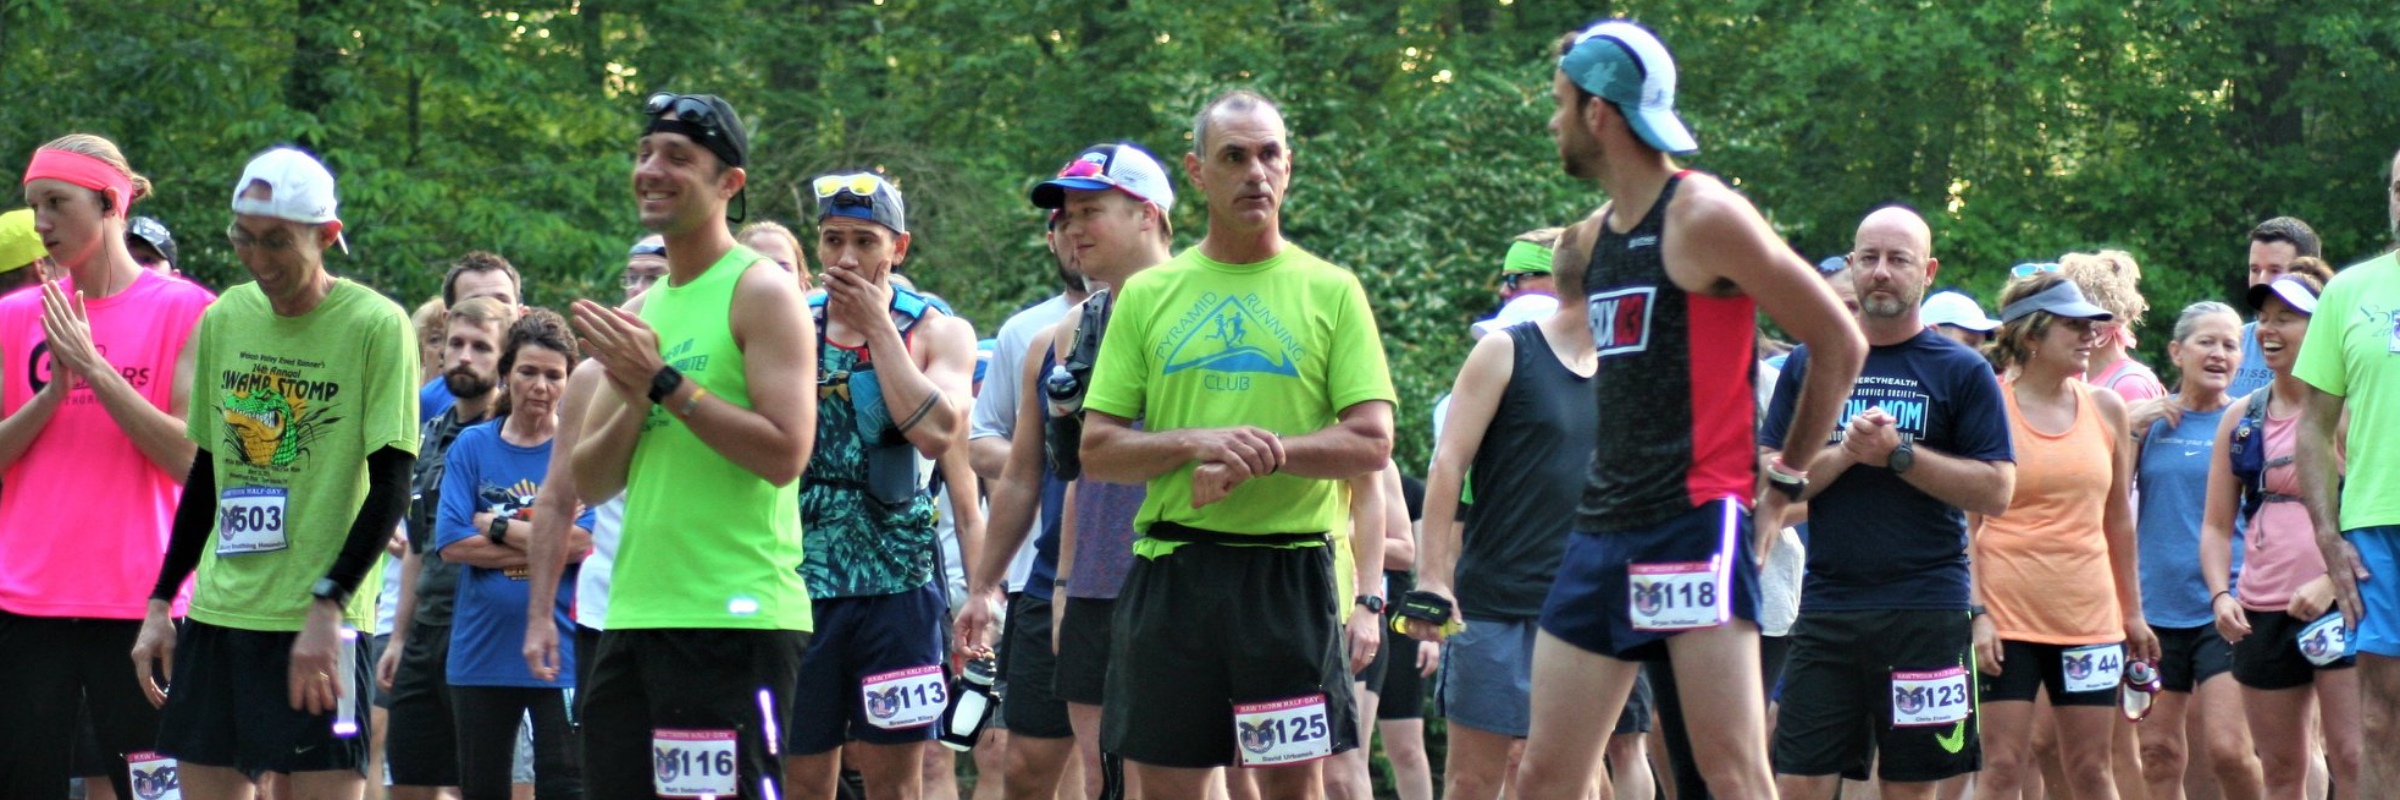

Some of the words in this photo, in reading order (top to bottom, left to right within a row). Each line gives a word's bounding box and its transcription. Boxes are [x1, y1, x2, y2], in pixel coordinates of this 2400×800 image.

[1155, 291, 1218, 360] PYRAMID
[1243, 292, 1306, 363] RUNNING
[277, 377, 339, 402] STOMP
[1204, 374, 1250, 391] CLUB
[1857, 388, 1886, 397] SERVICE
[1887, 389, 1917, 398] SOCIETY
[234, 505, 282, 533] 503
[1664, 581, 1715, 609] 118
[2098, 653, 2119, 673] 44
[900, 681, 946, 709] 113
[1926, 683, 1966, 708] 123
[1275, 713, 1328, 745] 125
[681, 749, 734, 777] 116
